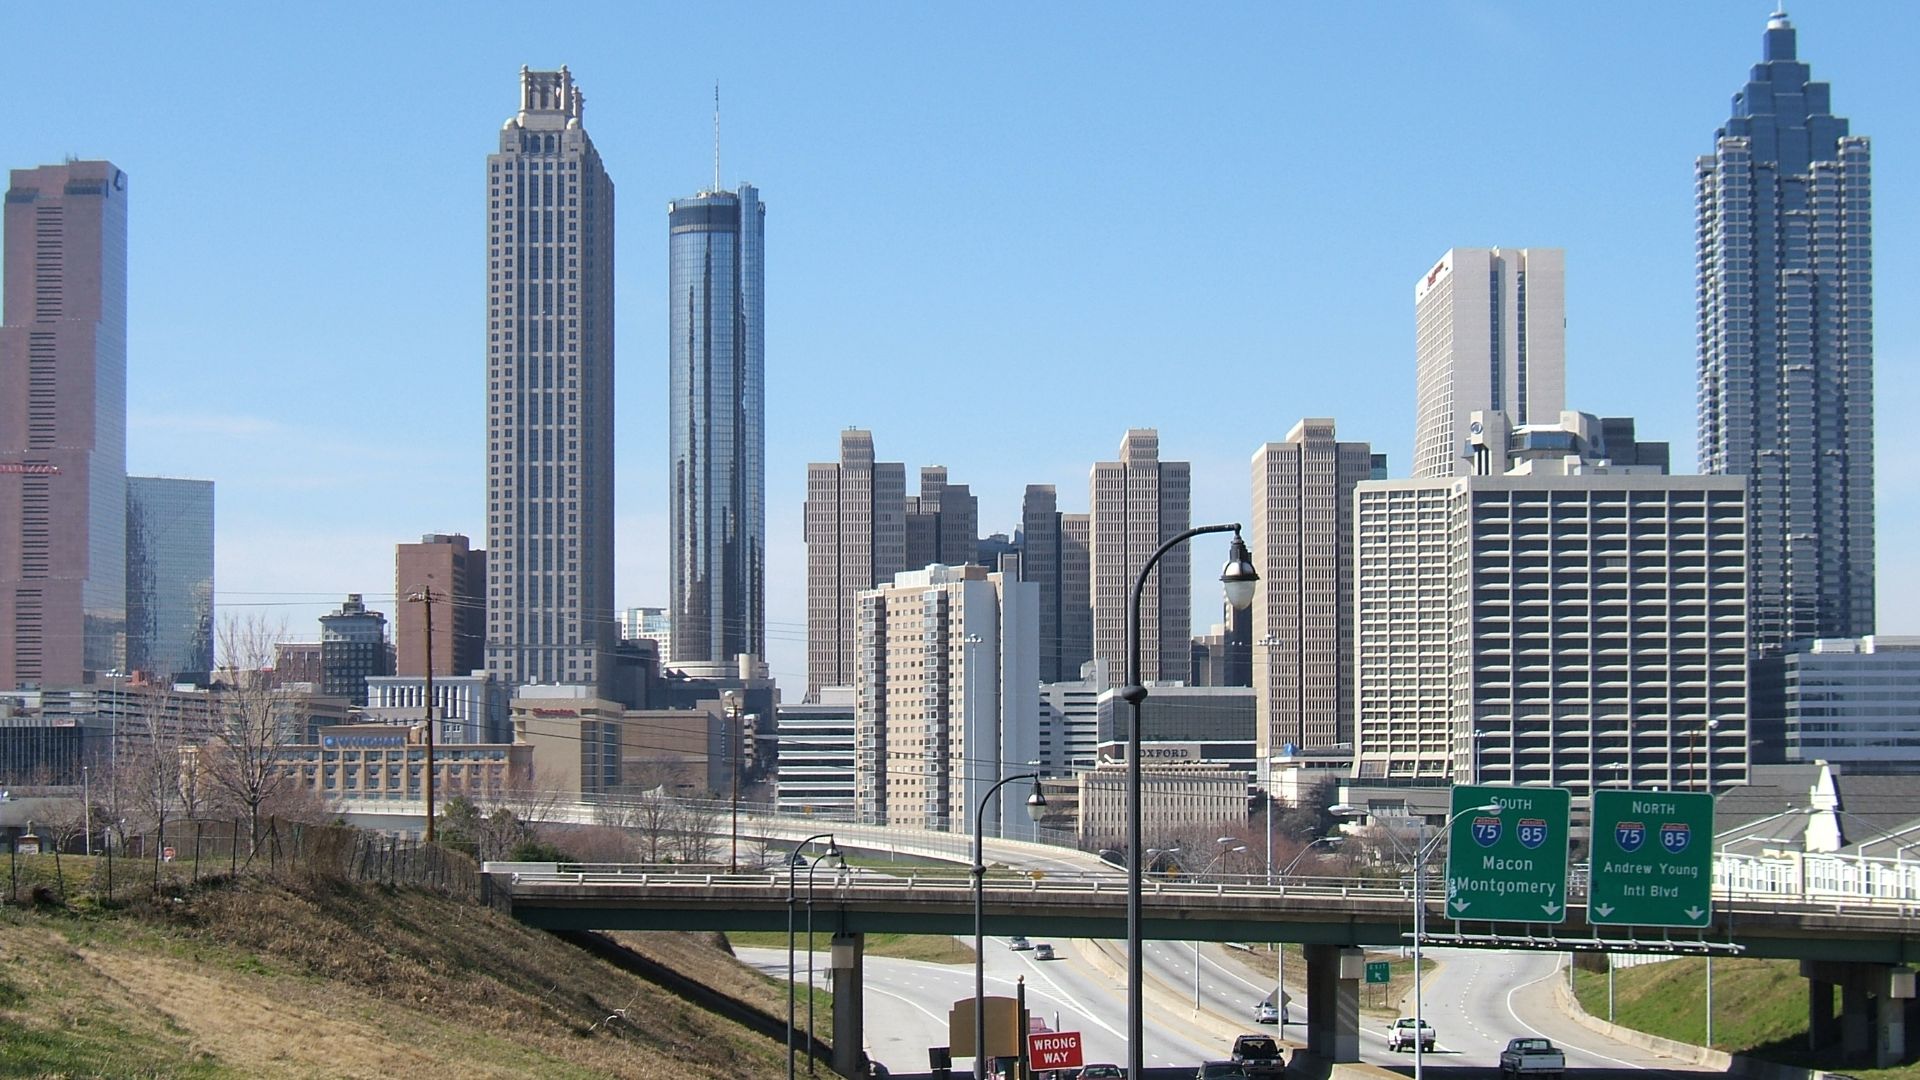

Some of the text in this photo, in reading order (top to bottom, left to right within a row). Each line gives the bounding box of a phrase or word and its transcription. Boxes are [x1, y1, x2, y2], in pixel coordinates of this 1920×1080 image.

[1139, 749, 1188, 757] OXFORD
[1632, 801, 1675, 815] NORTH
[1476, 825, 1497, 839] 75
[1521, 827, 1543, 842] 85
[1620, 829, 1640, 844] 75
[1664, 832, 1686, 847] 85
[1483, 855, 1533, 871] Macon
[1603, 862, 1698, 879] Andrew Young
[1457, 876, 1556, 897] Montgomery
[1624, 884, 1679, 897] Intl Blvd
[1034, 1037, 1076, 1051] WRONG
[1043, 1051, 1069, 1064] WAY
